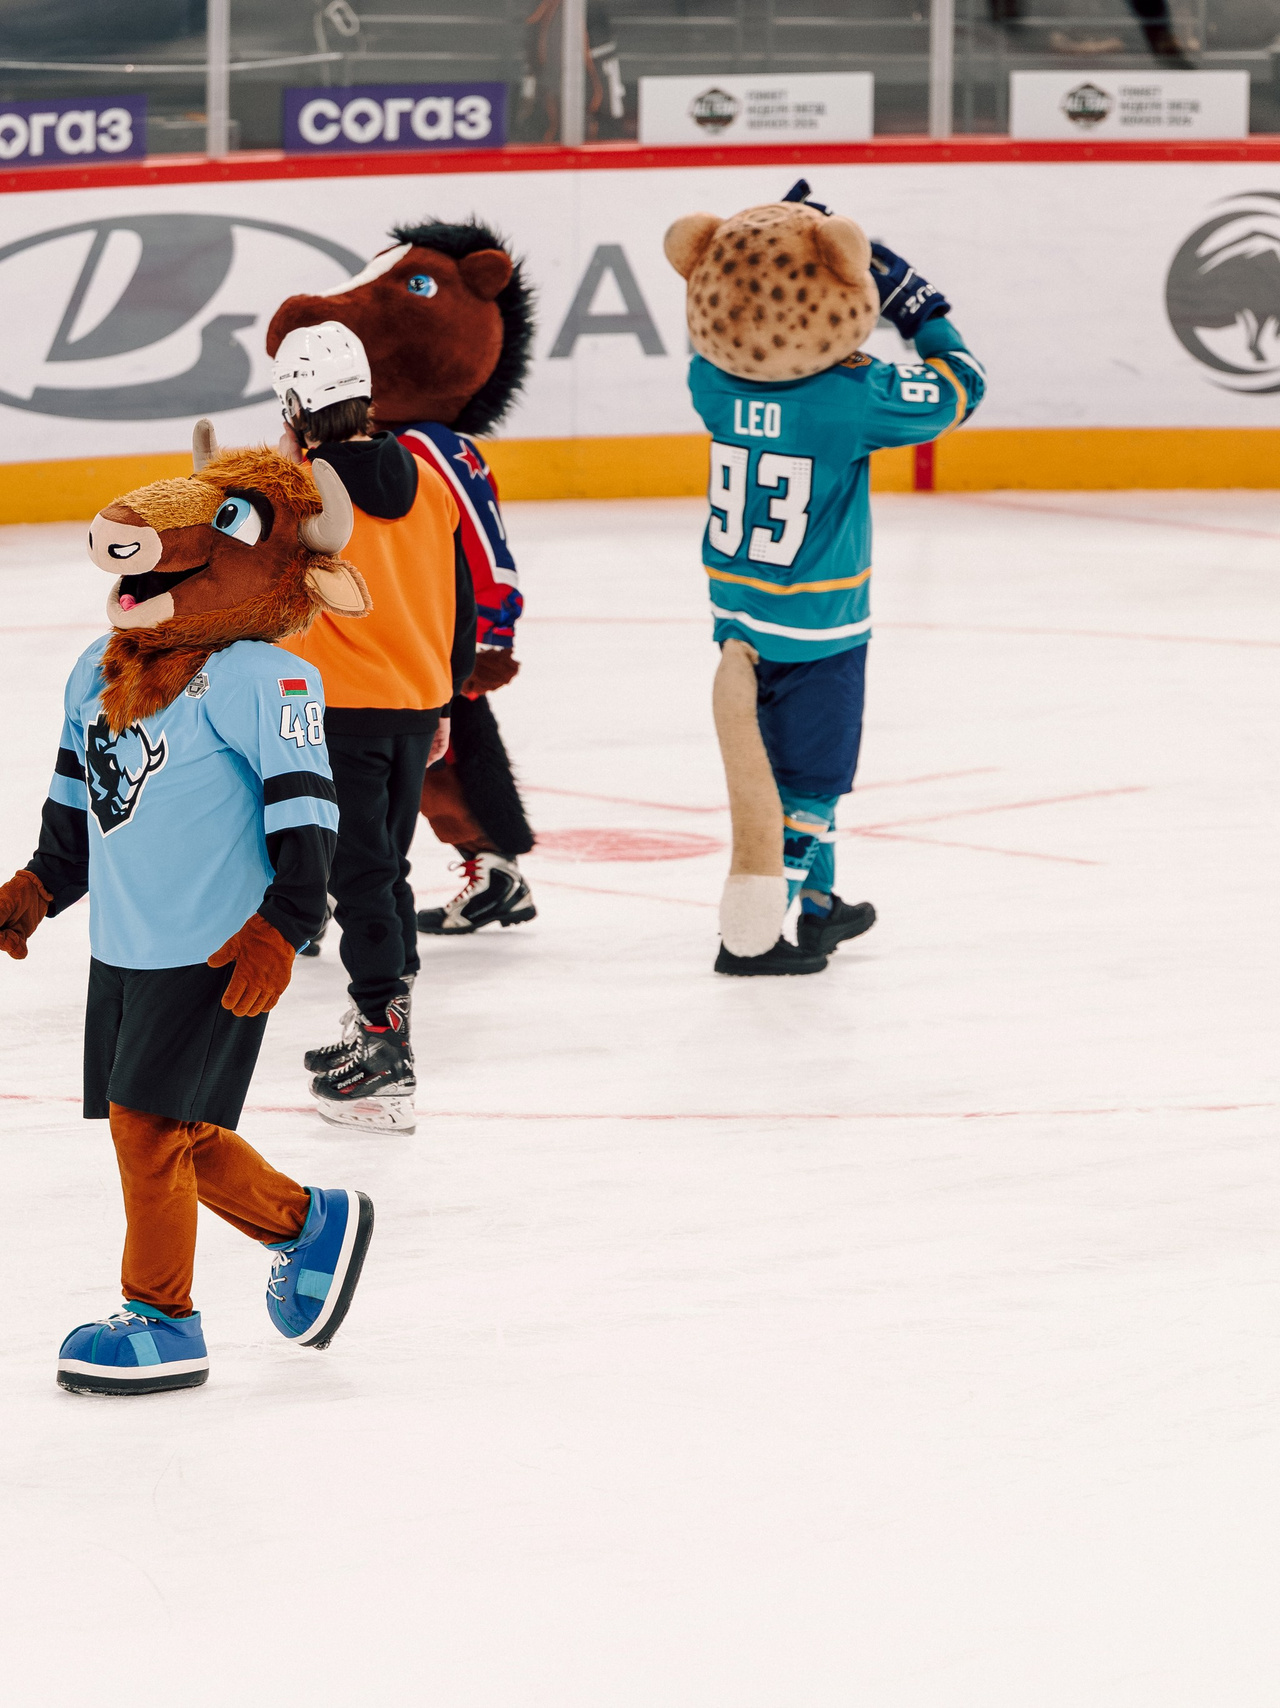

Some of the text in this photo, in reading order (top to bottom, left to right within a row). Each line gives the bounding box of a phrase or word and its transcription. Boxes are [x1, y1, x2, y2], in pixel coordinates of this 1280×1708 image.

[734, 399, 781, 438] LEO
[708, 440, 813, 567] 93
[280, 701, 325, 748] 48
